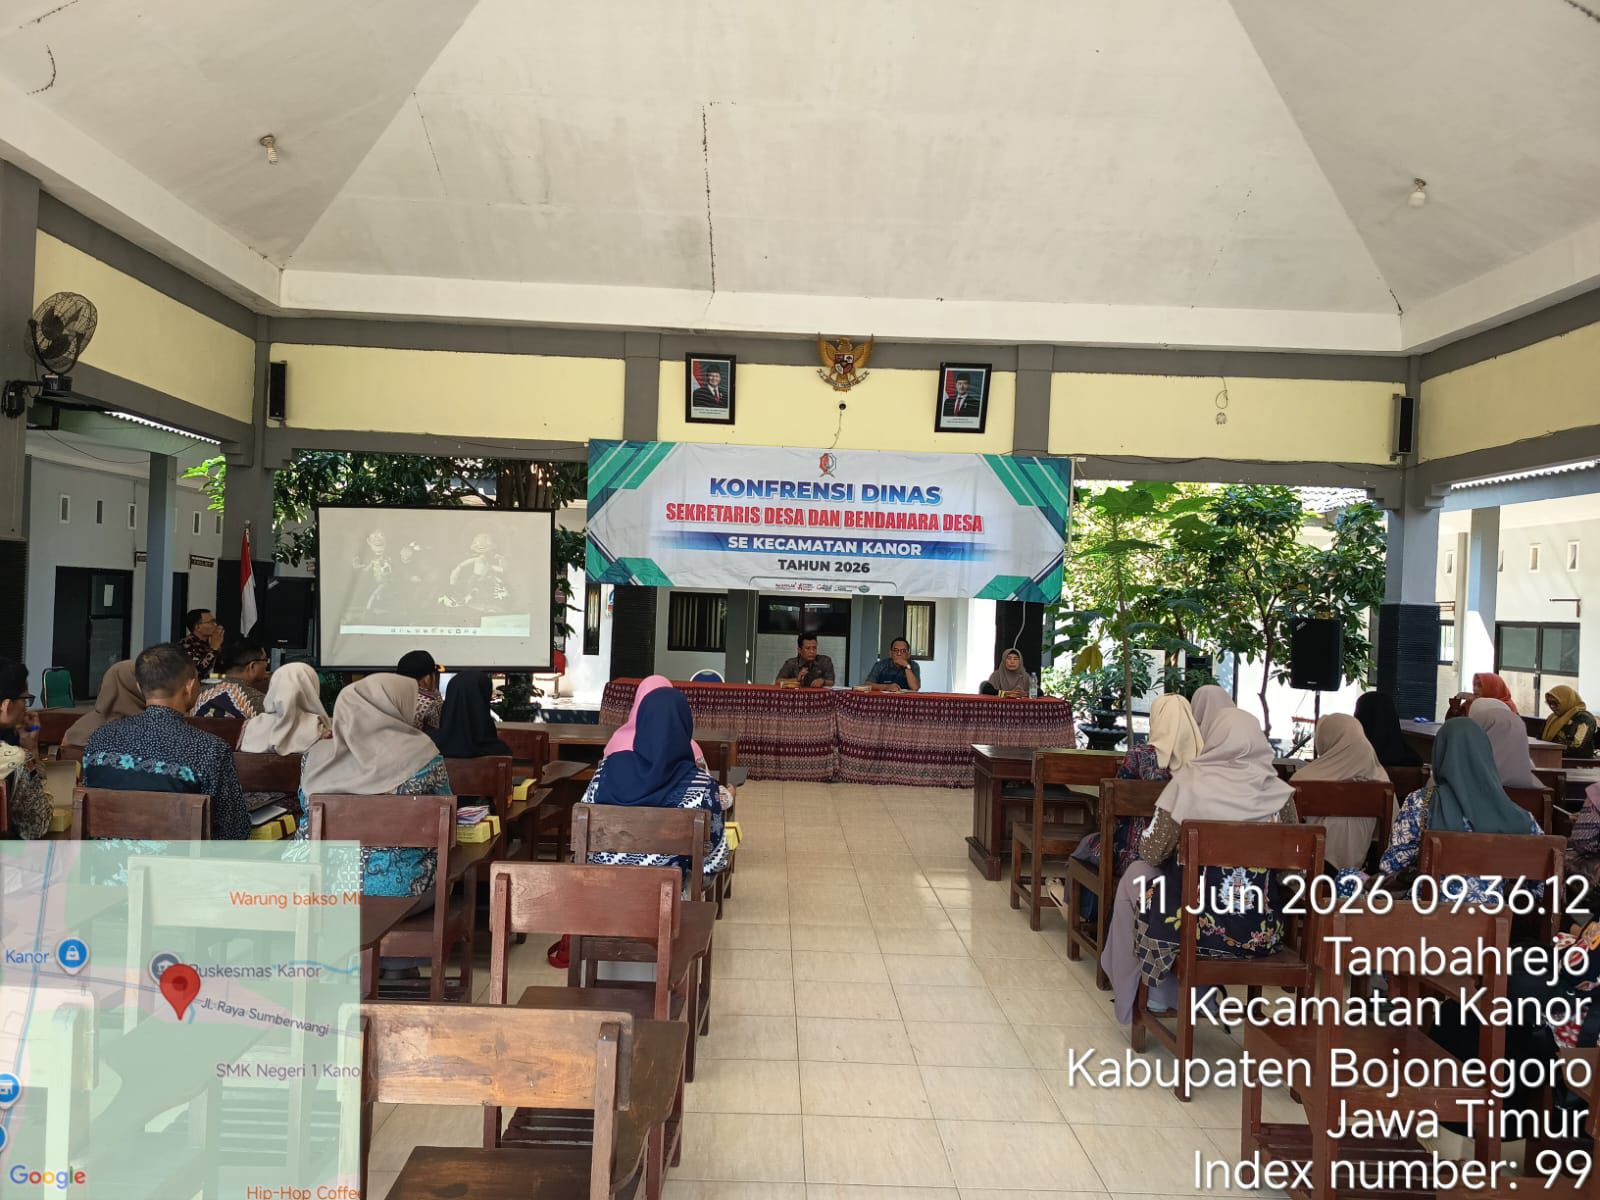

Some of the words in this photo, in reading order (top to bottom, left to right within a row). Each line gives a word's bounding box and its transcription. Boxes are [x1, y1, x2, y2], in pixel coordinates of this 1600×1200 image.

[710, 477, 853, 502] KONFRENSI
[861, 483, 942, 505] DINAS
[666, 502, 762, 525] SEKRETARIS
[764, 507, 806, 526] DESA
[808, 509, 840, 528] DAN
[844, 510, 939, 532] BENDAHARA
[943, 514, 983, 533] DESA
[728, 536, 749, 549] SE
[753, 537, 857, 554] KECAMATAN
[862, 541, 922, 556] KANOR
[778, 559, 830, 572] TAHUN
[834, 561, 870, 573] 2026
